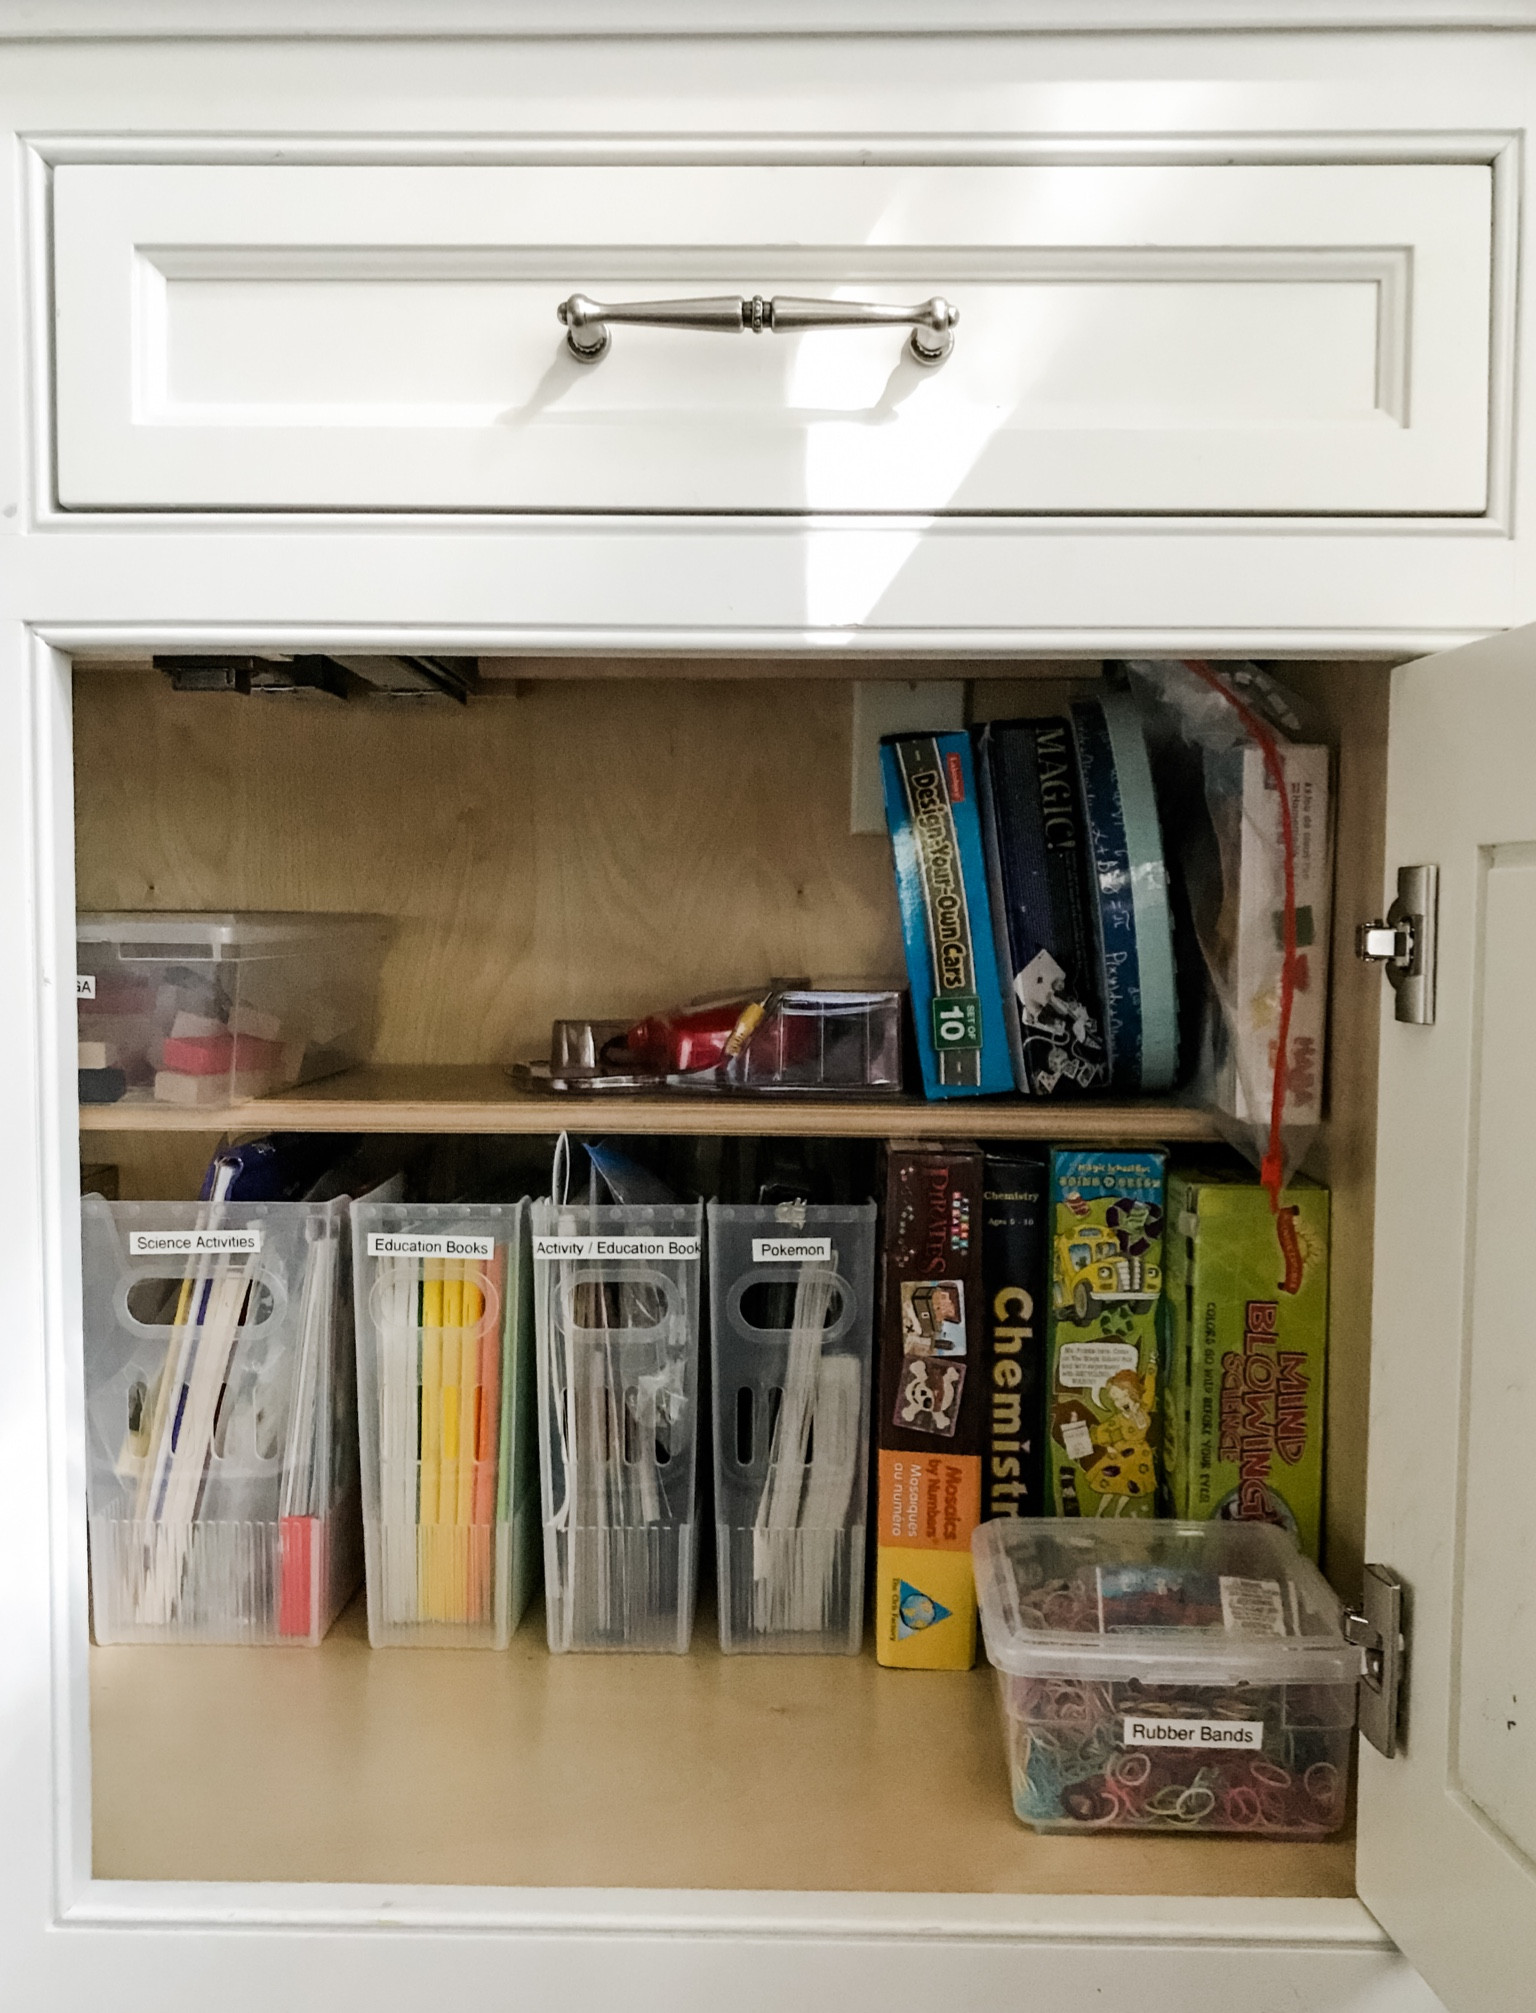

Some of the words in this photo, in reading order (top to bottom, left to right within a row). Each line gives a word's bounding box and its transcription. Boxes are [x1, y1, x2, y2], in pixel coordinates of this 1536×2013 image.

[1036, 728, 1076, 851] MAGIC!
[943, 942, 967, 989] Cars
[940, 1005, 966, 1041] 10
[966, 1004, 975, 1024] SET
[967, 1027, 977, 1041] OF
[983, 1191, 1040, 1203] Chemistry
[917, 1166, 949, 1275] PIRATES
[137, 1236, 191, 1251] Science
[196, 1235, 255, 1249] Activities
[375, 1238, 442, 1253] Education
[446, 1241, 489, 1255] Books
[536, 1241, 584, 1256] Activity
[597, 1241, 664, 1255] Education
[668, 1241, 700, 1255] Book
[761, 1243, 825, 1257] Pokemon
[990, 1286, 1034, 1518] Chemistr
[1218, 1352, 1246, 1462] SCIENCE
[1239, 1301, 1279, 1520] BLOWING
[1277, 1352, 1311, 1466] MIND
[926, 1458, 942, 1477] by
[1201, 1439, 1212, 1470] YOUR
[893, 1462, 903, 1479] au
[892, 1486, 905, 1537] numéro
[943, 1464, 963, 1540] Mosaics
[1132, 1724, 1196, 1742] Rubber
[1200, 1726, 1254, 1743] Bands
